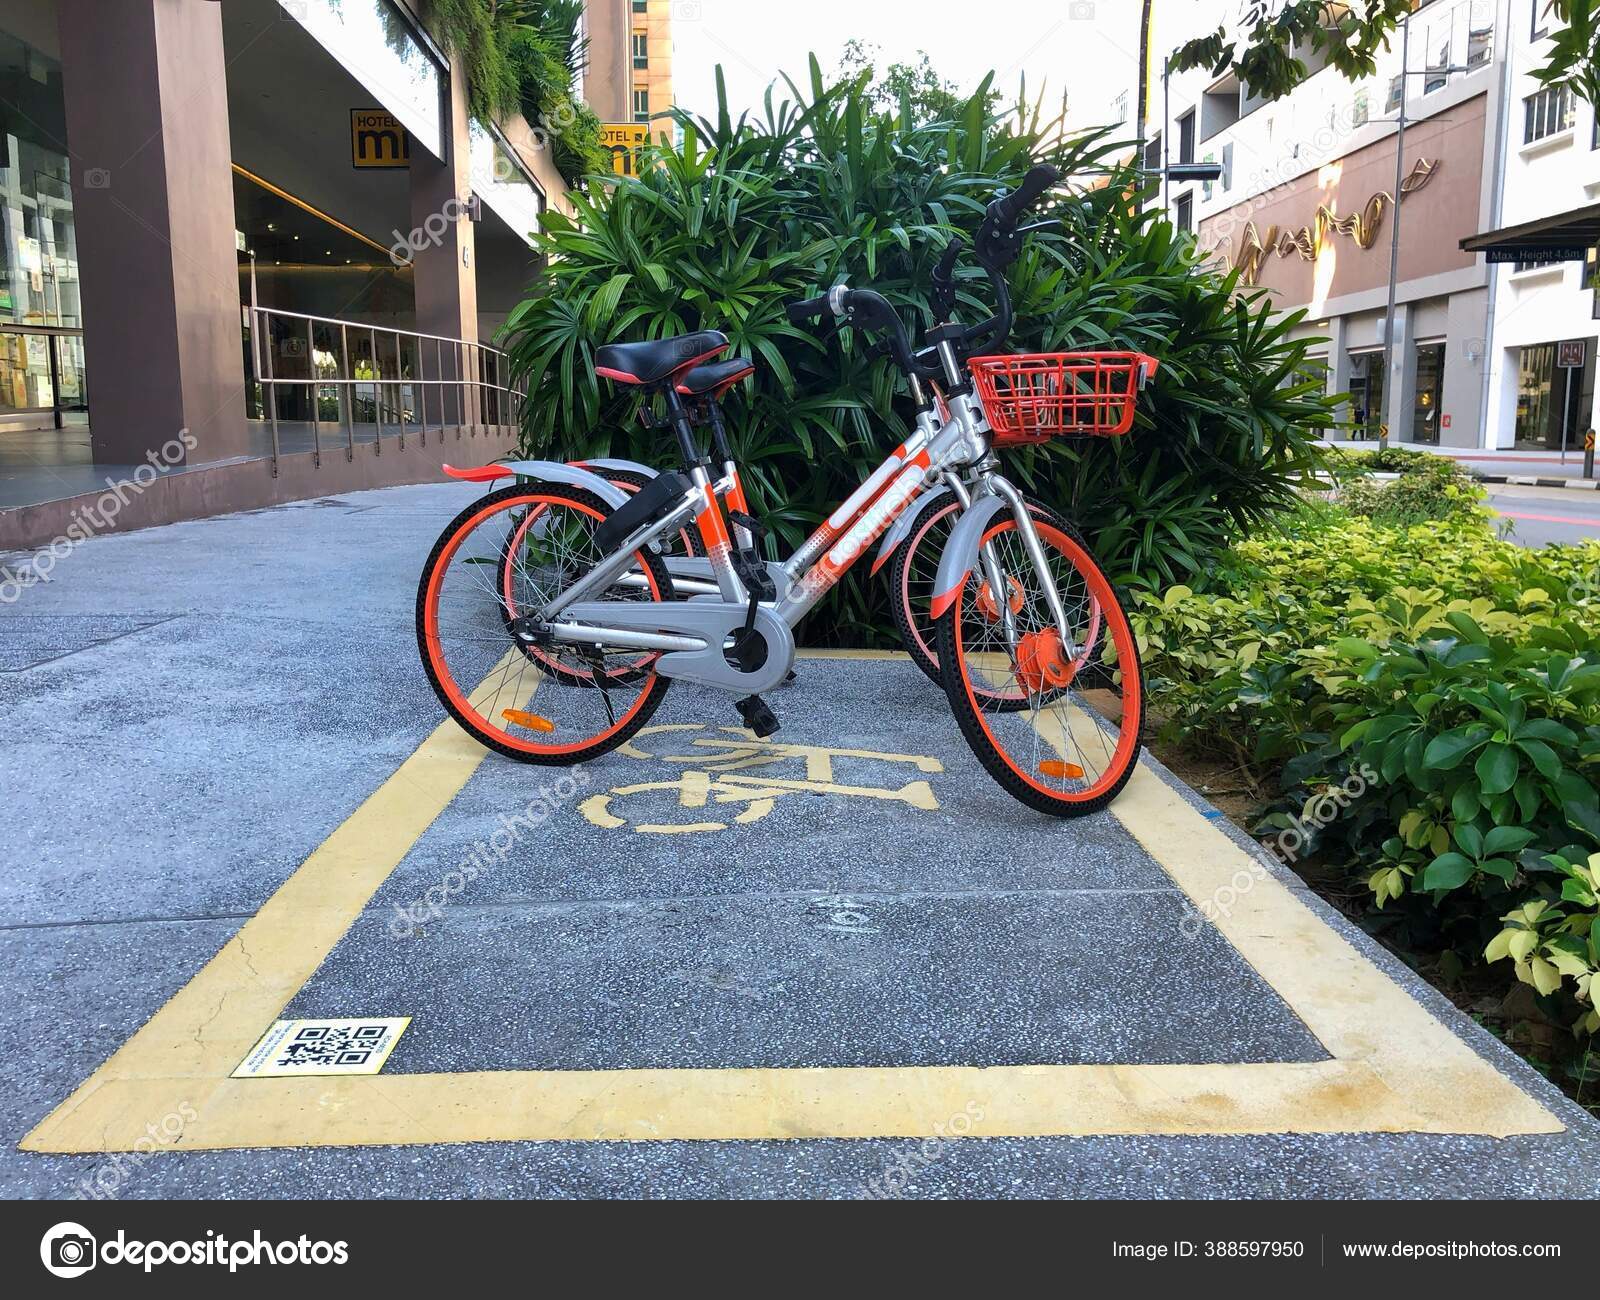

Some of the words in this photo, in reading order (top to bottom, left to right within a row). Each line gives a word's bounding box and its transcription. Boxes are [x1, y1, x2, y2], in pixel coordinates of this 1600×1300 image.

[357, 116, 399, 127] HOTEL
[600, 130, 631, 142] OTEL
[1519, 249, 1552, 261] Height
